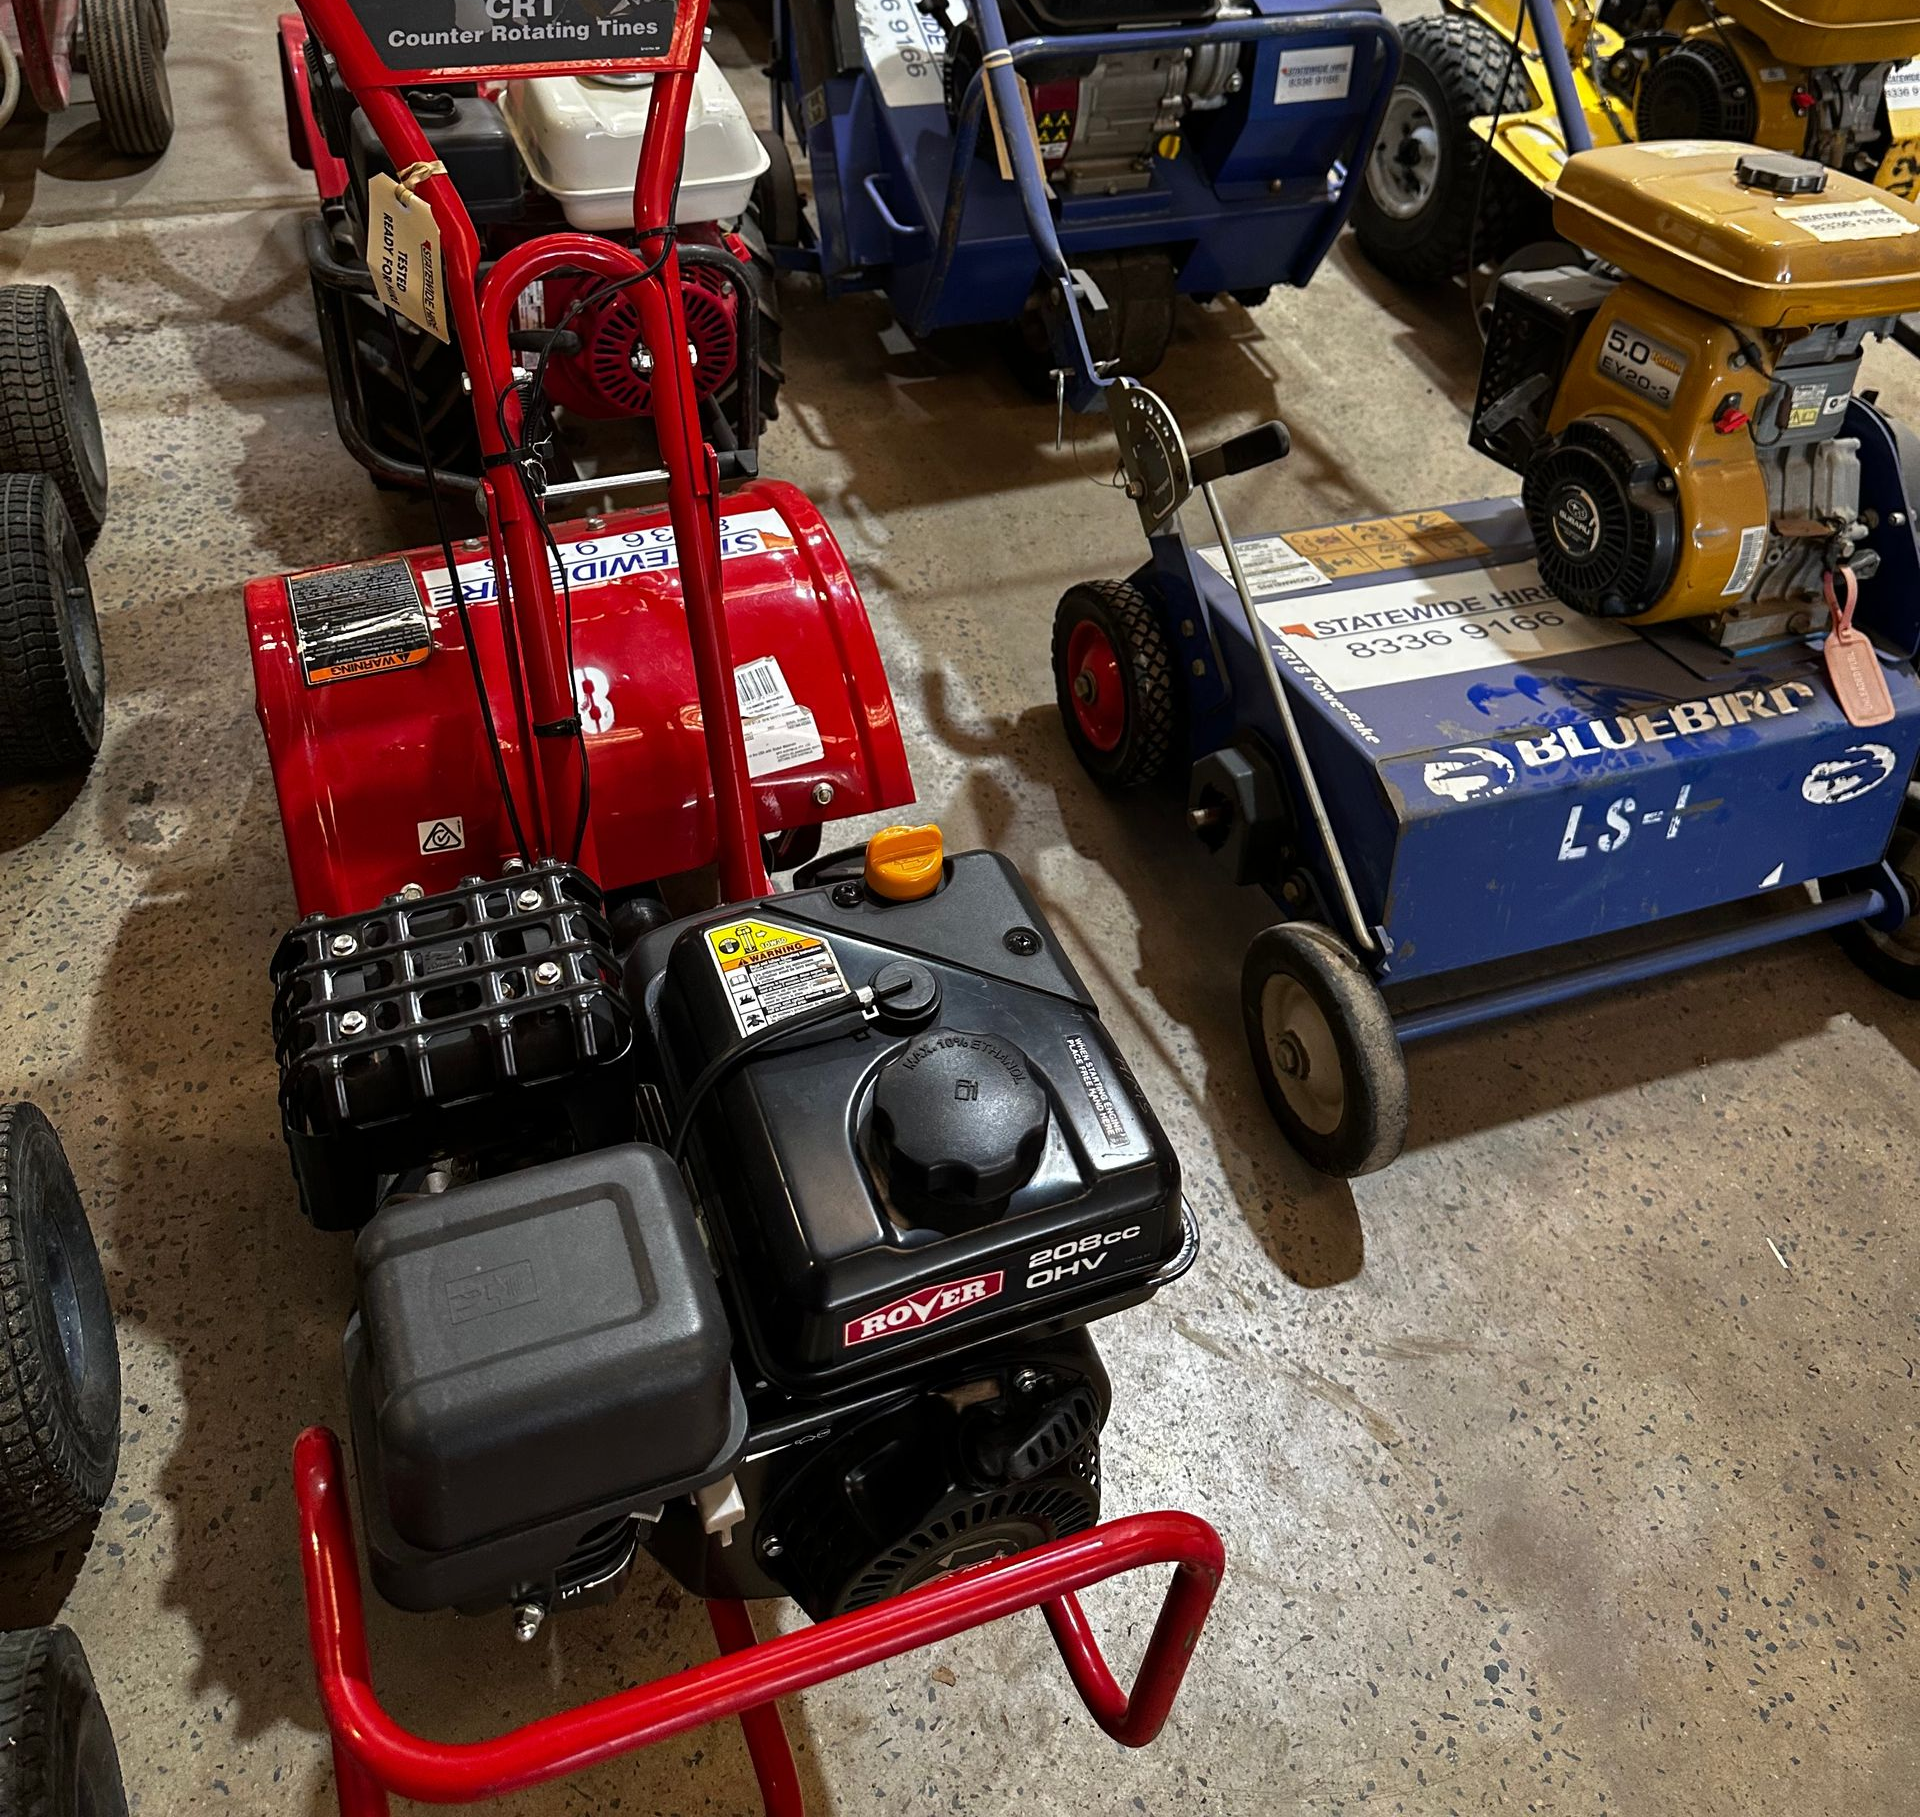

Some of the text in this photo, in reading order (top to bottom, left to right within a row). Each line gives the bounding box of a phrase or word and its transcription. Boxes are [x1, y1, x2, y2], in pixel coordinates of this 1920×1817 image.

[388, 19, 658, 47] Counter Rotating Tines
[888, 19, 928, 77] 9166
[382, 212, 394, 257] READY
[382, 257, 393, 284] FOR
[396, 250, 408, 293] TESTED
[423, 248, 435, 308] STATEWIDE
[1608, 330, 1650, 365] 5.0
[1602, 355, 1670, 400] EY20-3
[1559, 509, 1591, 536] SUBARU
[1314, 597, 1486, 635] STATEWIDE
[1346, 610, 1565, 658] 8336 9166
[330, 656, 396, 676] WARNING
[1271, 643, 1381, 746] PR18 PowerRake
[749, 943, 803, 963] WARNING
[937, 1036, 969, 1050] 10%
[969, 1039, 1026, 1085] ETHANOL
[1075, 1037, 1090, 1061] WHEN
[1085, 1061, 1108, 1101] STARTING
[1066, 1039, 1116, 1136] PLACE FREE HAND HERE
[1028, 1225, 1141, 1269] 208cc
[1025, 1252, 1108, 1289] OHV
[860, 1279, 986, 1338] ROVER
